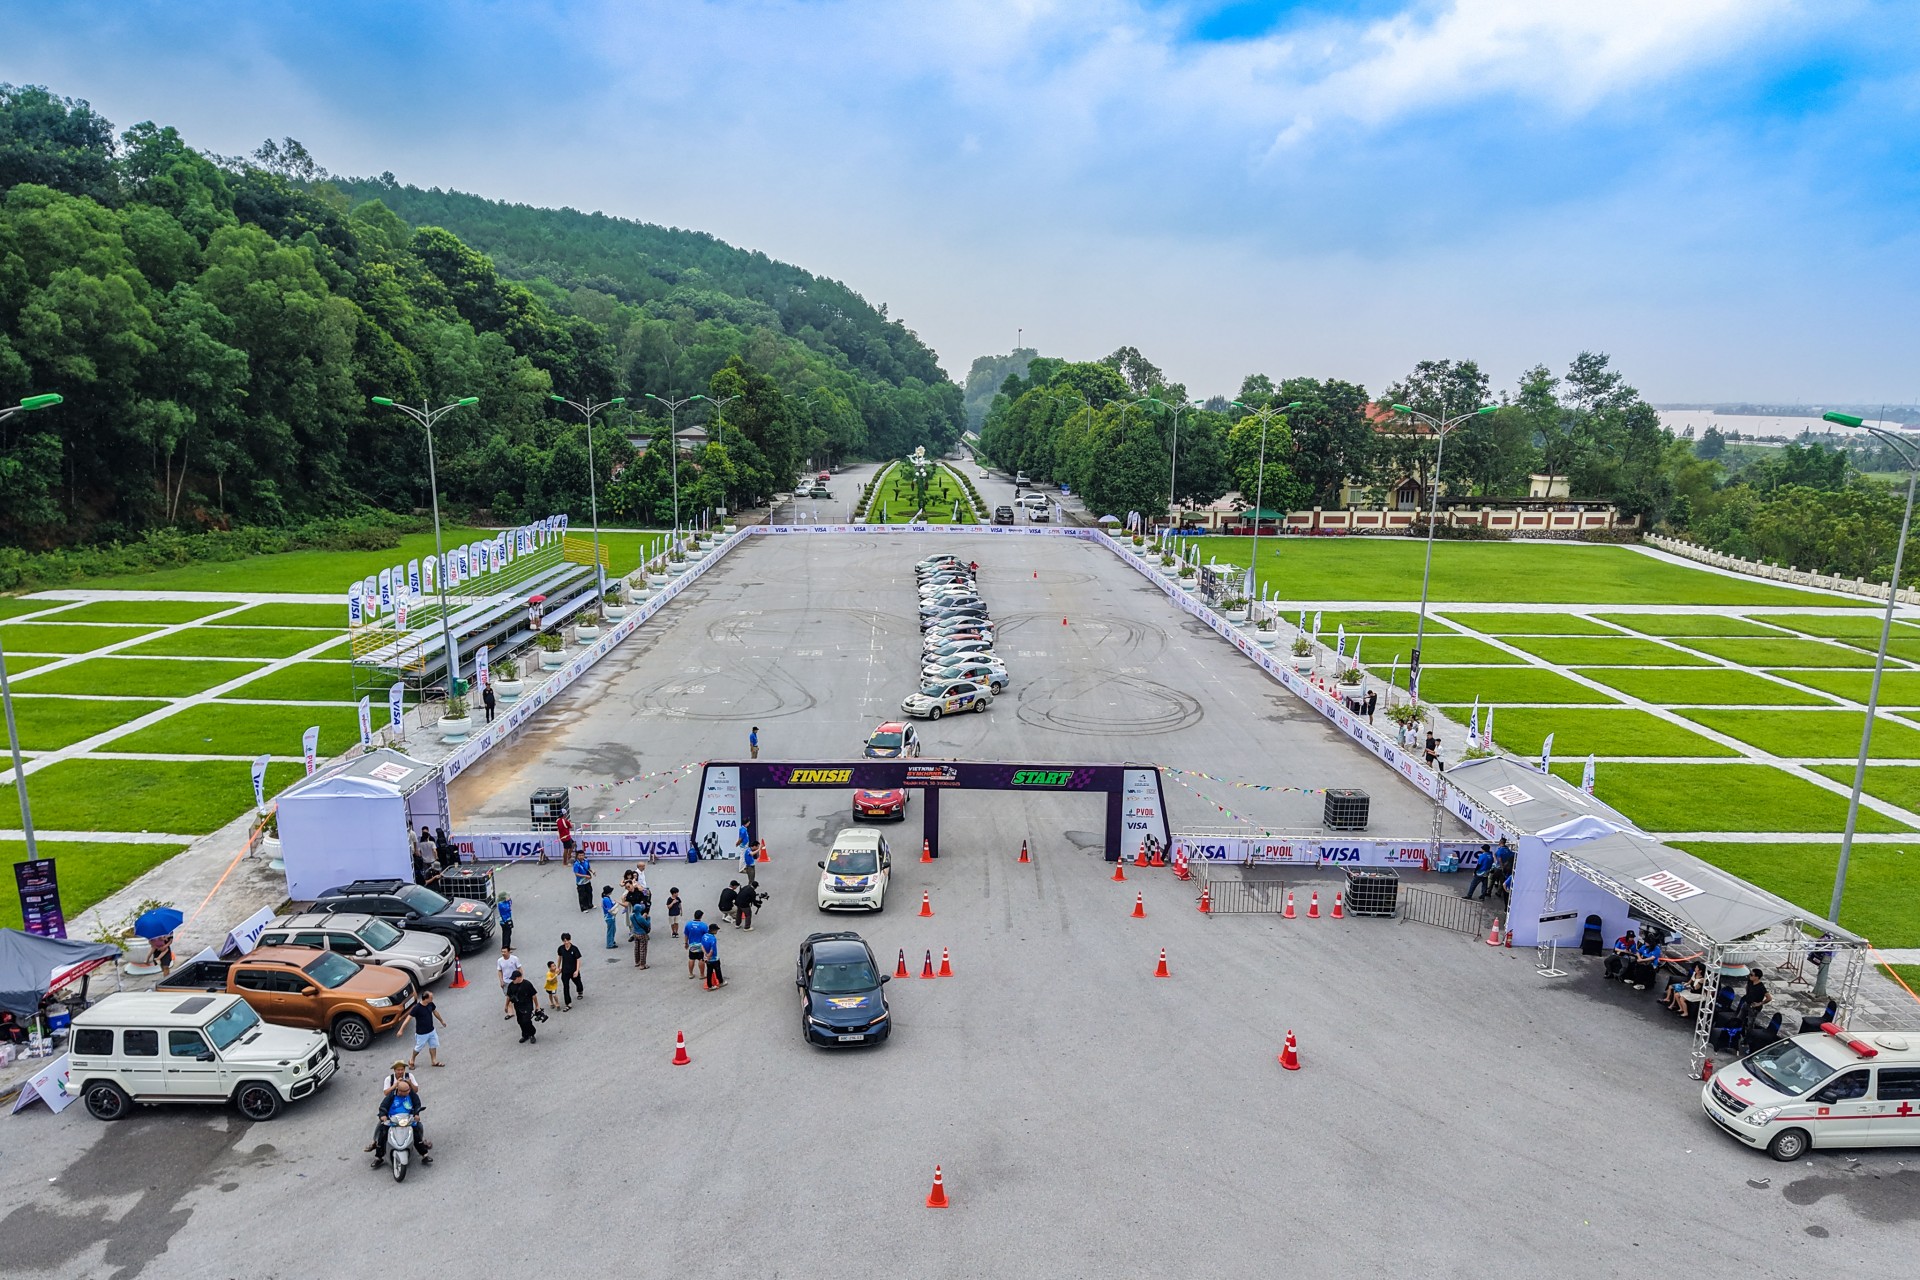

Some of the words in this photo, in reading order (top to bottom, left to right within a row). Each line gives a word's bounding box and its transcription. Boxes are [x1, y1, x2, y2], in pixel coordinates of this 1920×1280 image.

[410, 572, 419, 593] VISA
[381, 584, 390, 606] VISA
[351, 596, 360, 619] VISA
[392, 697, 401, 725] VISA
[1353, 723, 1363, 740] VISA
[1383, 745, 1395, 763] VISA
[448, 759, 461, 777] VISA
[789, 769, 853, 784] FINISH
[1012, 771, 1072, 785] START
[717, 805, 737, 813] PVOIL
[1136, 808, 1154, 816] PVOIL
[1458, 800, 1472, 822] VISA
[715, 819, 737, 828] VISA
[1485, 819, 1495, 836] PVOIL
[501, 842, 541, 856] VISA
[583, 841, 611, 852] PVOIL
[636, 841, 679, 854] VISA
[1266, 845, 1293, 857] PVOIL
[1318, 847, 1360, 861] VISA
[1399, 848, 1425, 860] PVOIL
[1641, 872, 1694, 899] PVOIL
